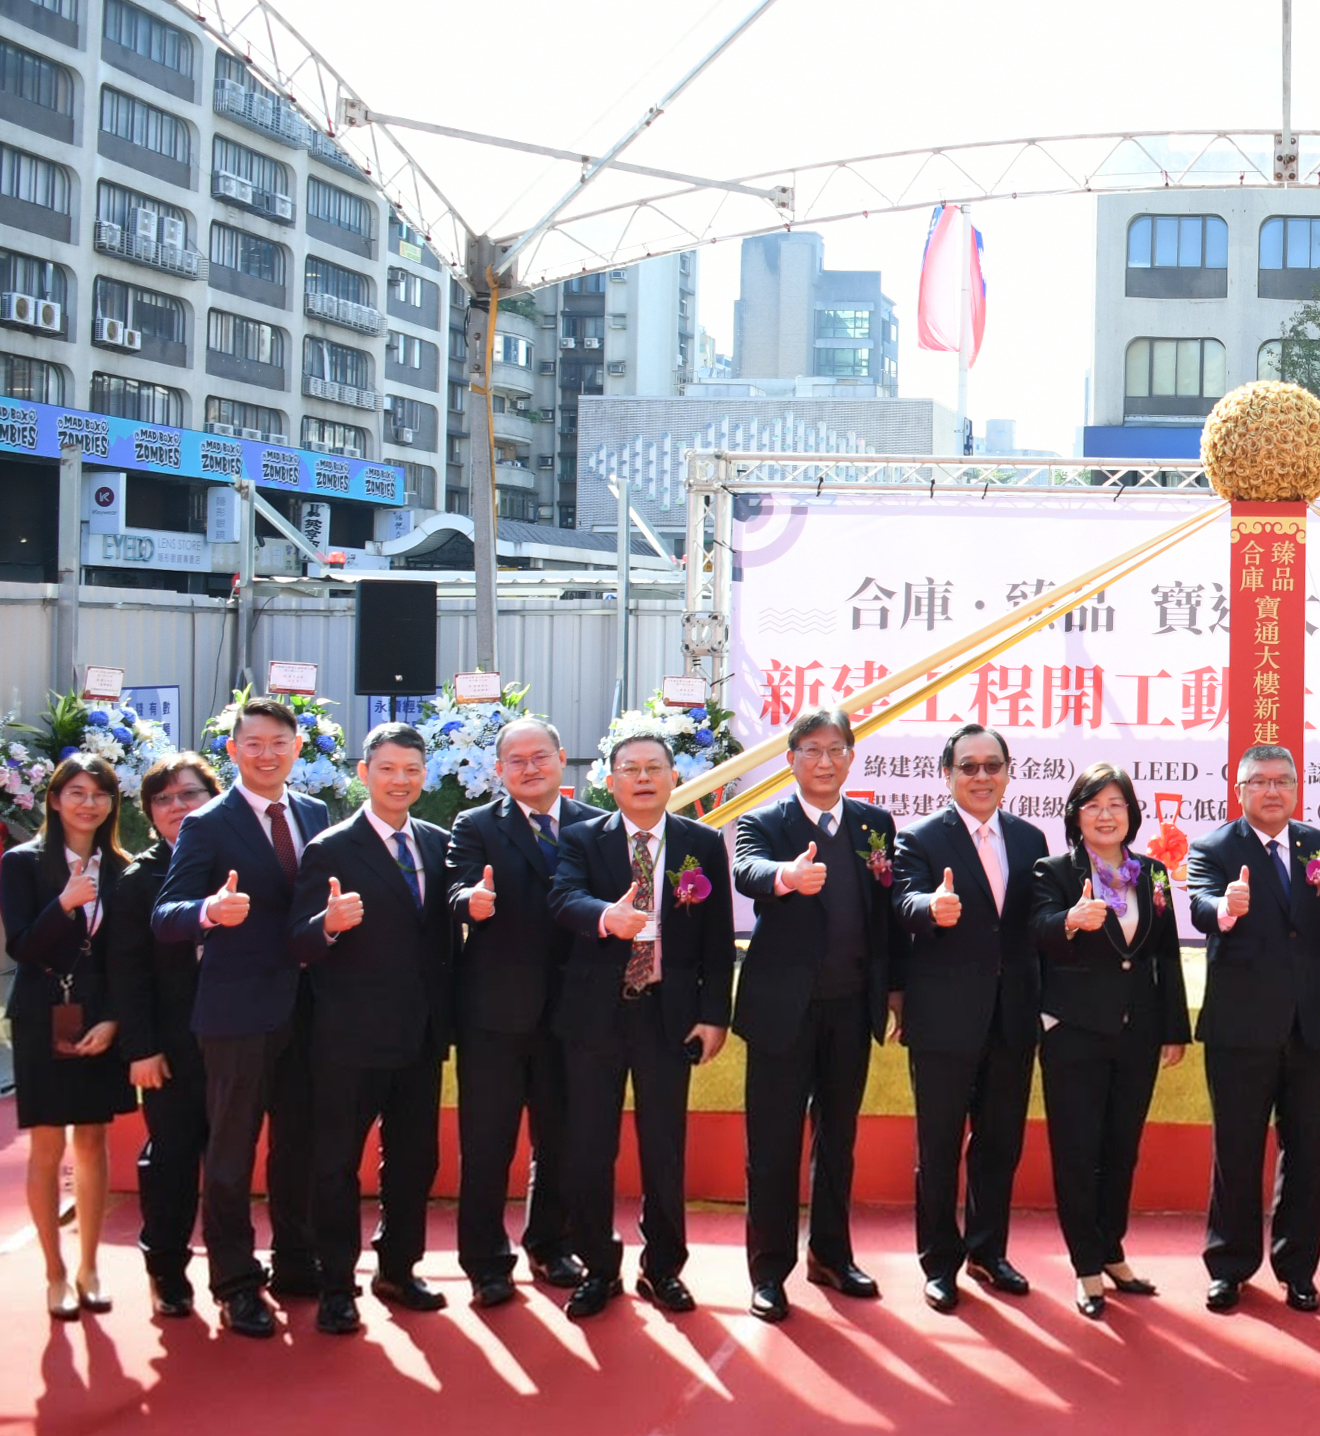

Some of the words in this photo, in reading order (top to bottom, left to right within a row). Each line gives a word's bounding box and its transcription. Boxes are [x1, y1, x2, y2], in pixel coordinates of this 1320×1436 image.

[64, 415, 82, 429] MAD
[0, 424, 37, 447] MBIES
[58, 431, 108, 456] ZOMBIES
[140, 428, 157, 440] MAD
[135, 443, 180, 467] ZOMBIES
[206, 440, 221, 451] MAD
[201, 453, 241, 475] ZOMBIES
[266, 450, 280, 461] MAD
[262, 463, 299, 484] ZOMBIES
[316, 472, 349, 491] ZOMBIES
[365, 480, 395, 498] ZOMBIES
[157, 537, 176, 550] LENS
[177, 539, 201, 551] STORE
[1252, 595, 1282, 745] 寶通大樓新建
[1132, 761, 1198, 781] LEED
